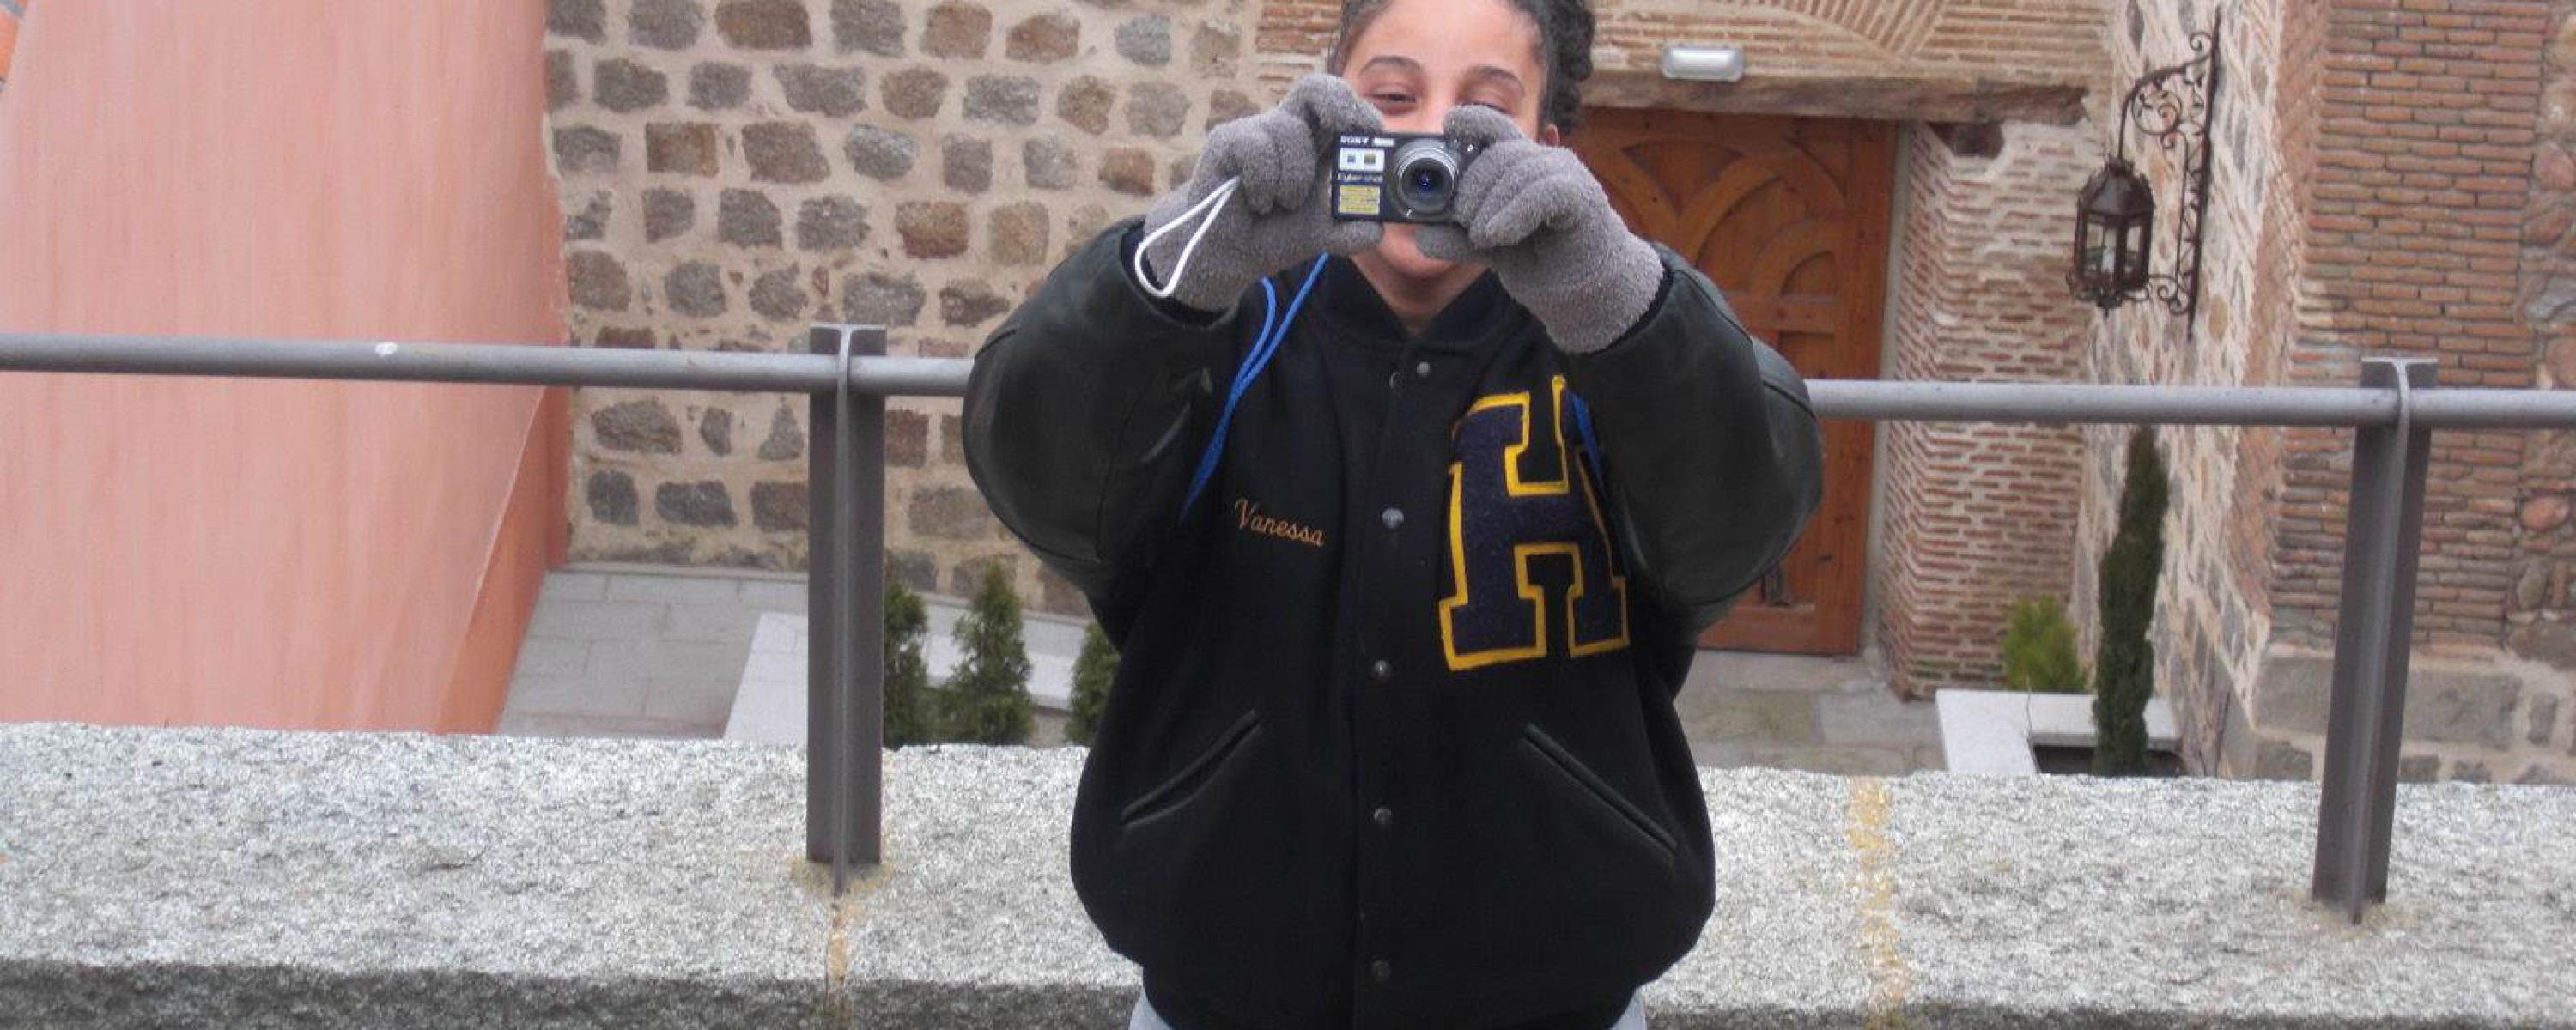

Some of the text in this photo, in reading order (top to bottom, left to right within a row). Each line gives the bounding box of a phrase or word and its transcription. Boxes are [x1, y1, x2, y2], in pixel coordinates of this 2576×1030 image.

[1340, 136, 1370, 144] SONY
[1234, 497, 1326, 548] Vanessa
[1439, 375, 1630, 671] H
